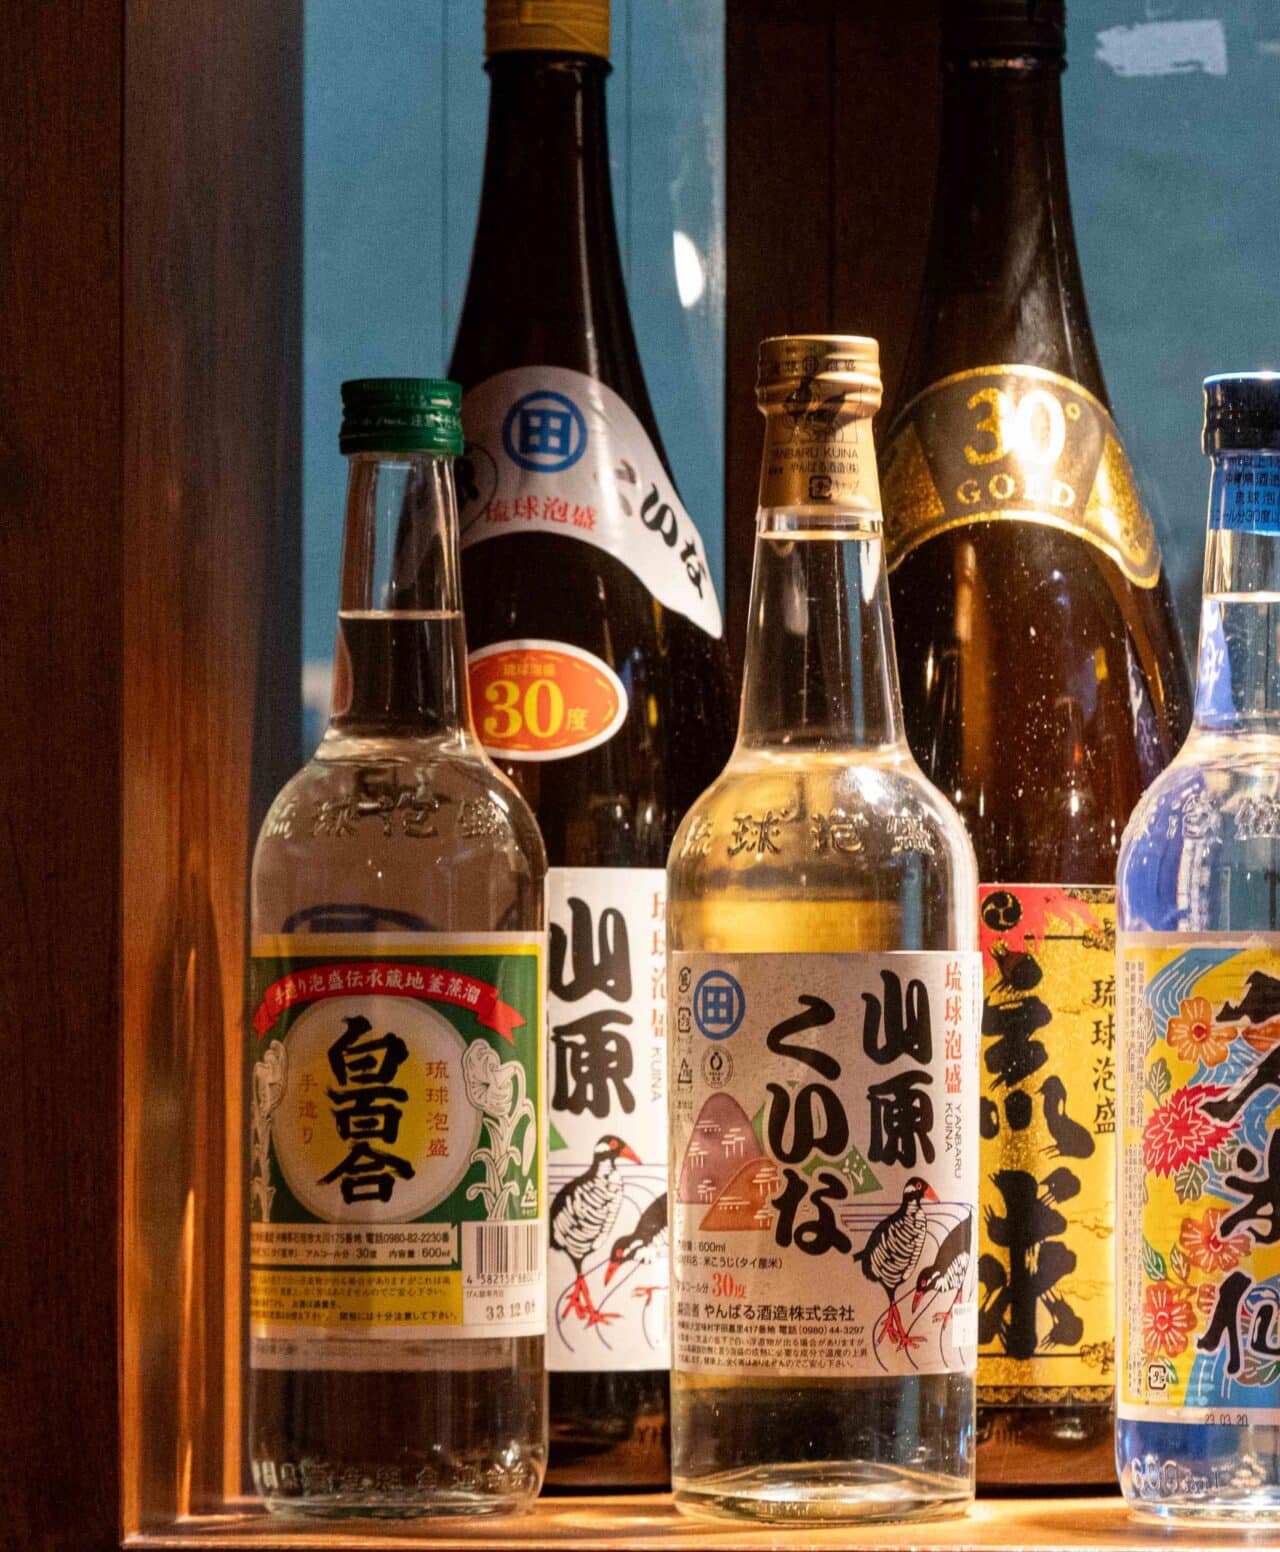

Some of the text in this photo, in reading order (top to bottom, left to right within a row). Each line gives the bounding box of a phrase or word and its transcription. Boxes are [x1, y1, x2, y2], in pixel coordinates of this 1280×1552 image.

[957, 474, 1076, 508] GOLD
[484, 679, 589, 737] 30度
[861, 969, 935, 1168] 山原
[944, 961, 963, 1095] 琉球泡盛
[1092, 974, 1116, 1135] 琉球泡盛
[316, 1015, 416, 1204] 白百合
[425, 1060, 450, 1160] 琉球泡盛
[765, 993, 853, 1256] くいな
[943, 1102, 953, 1154] KUINA
[953, 1102, 963, 1180] YANBARU
[703, 1304, 856, 1322] やんばる酒造株式会社
